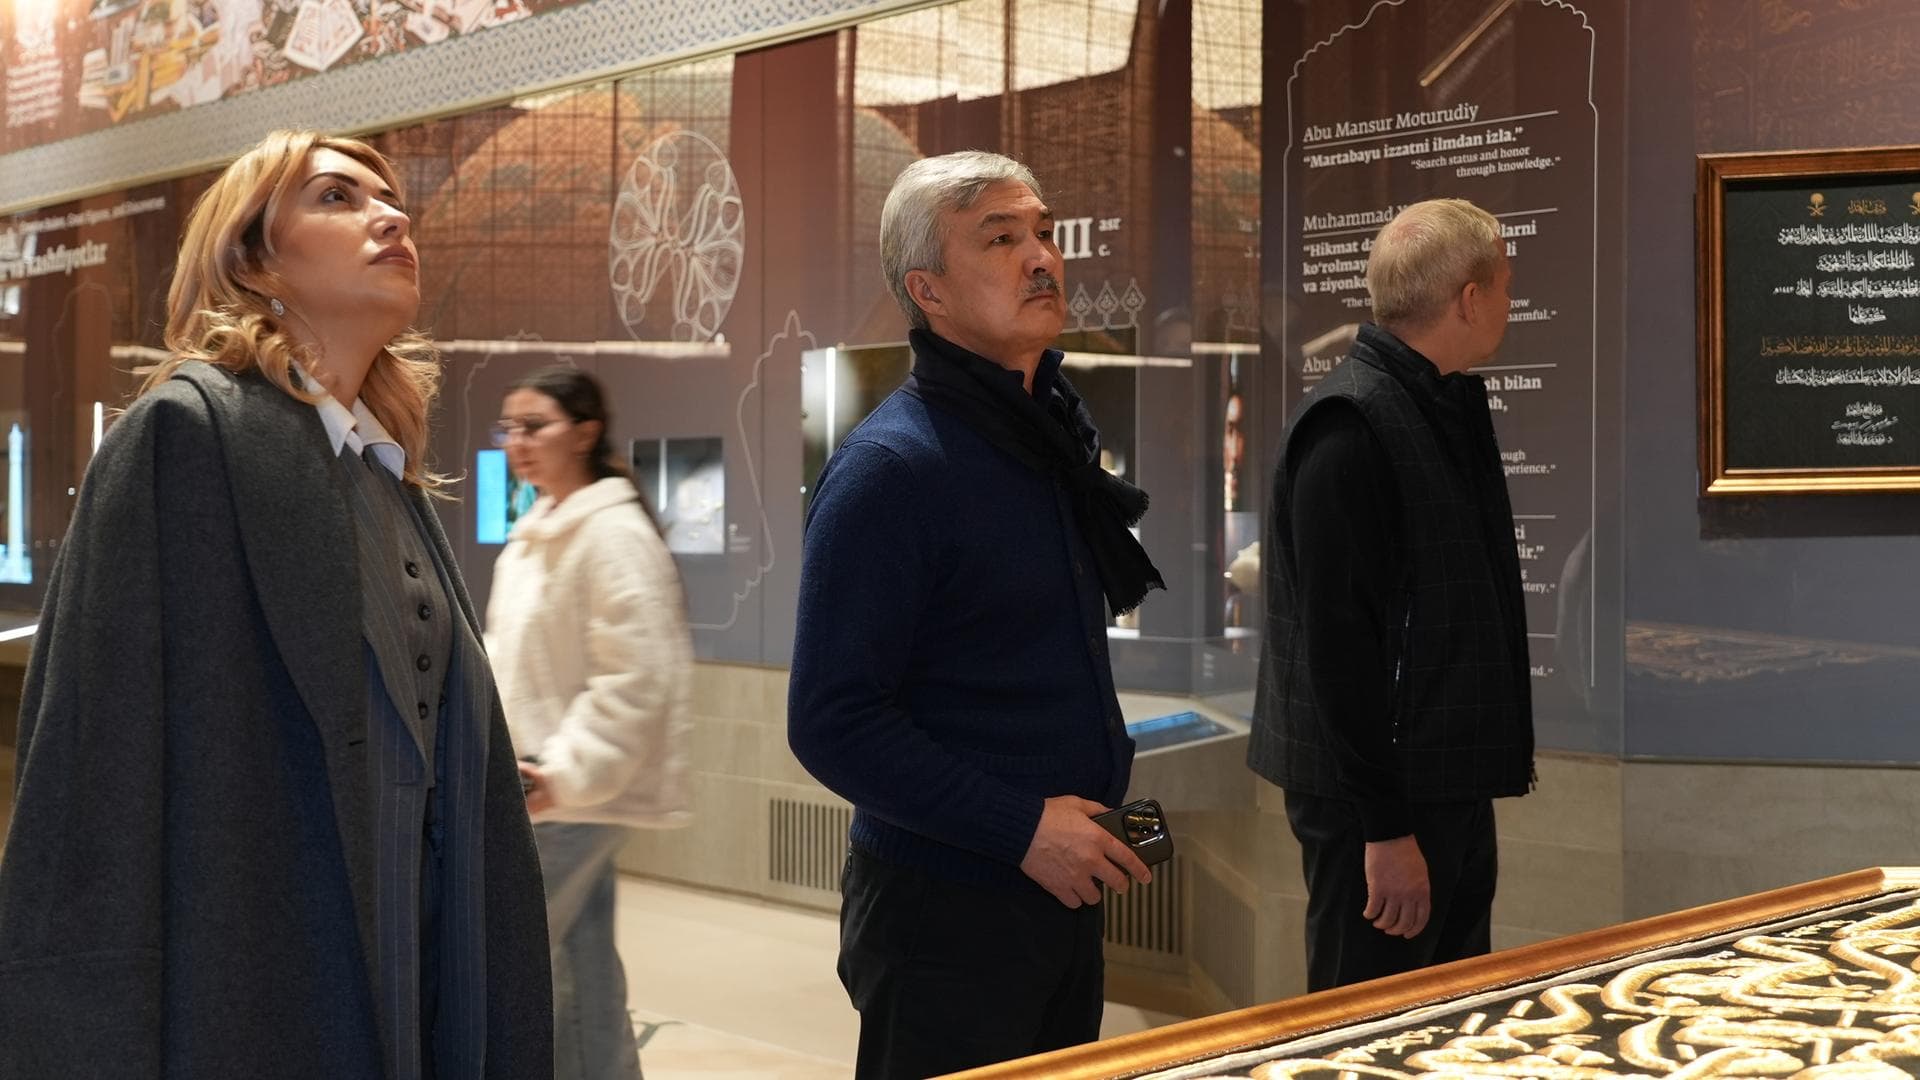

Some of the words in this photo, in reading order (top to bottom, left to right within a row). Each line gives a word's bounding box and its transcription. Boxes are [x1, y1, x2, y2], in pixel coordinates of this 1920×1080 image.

[1303, 126, 1332, 143] Abu
[1335, 117, 1393, 138] Mansur
[1395, 102, 1479, 130] Moturudiy
[1303, 146, 1381, 169] “Martabayu
[1383, 138, 1430, 159] izzatni
[1432, 131, 1483, 152] ilmdan
[1486, 126, 1523, 145] izla.”
[1411, 155, 1447, 170] “Search
[1448, 152, 1478, 165] status
[1479, 148, 1498, 161] and
[1500, 145, 1531, 158] honor
[1456, 163, 1496, 178] through
[1497, 156, 1561, 173] knowledge.”
[1098, 217, 1122, 231] asr
[1303, 206, 1394, 231] Muhammad
[1501, 219, 1537, 238] larni
[1099, 245, 1111, 257] c.
[1303, 241, 1358, 258] “Hikmat
[1303, 281, 1318, 293] va
[1342, 297, 1363, 308] “The
[1303, 356, 1332, 373] Abu
[1504, 375, 1542, 391] bilan
[1500, 449, 1526, 463] ough
[1504, 463, 1556, 477] perience.”
